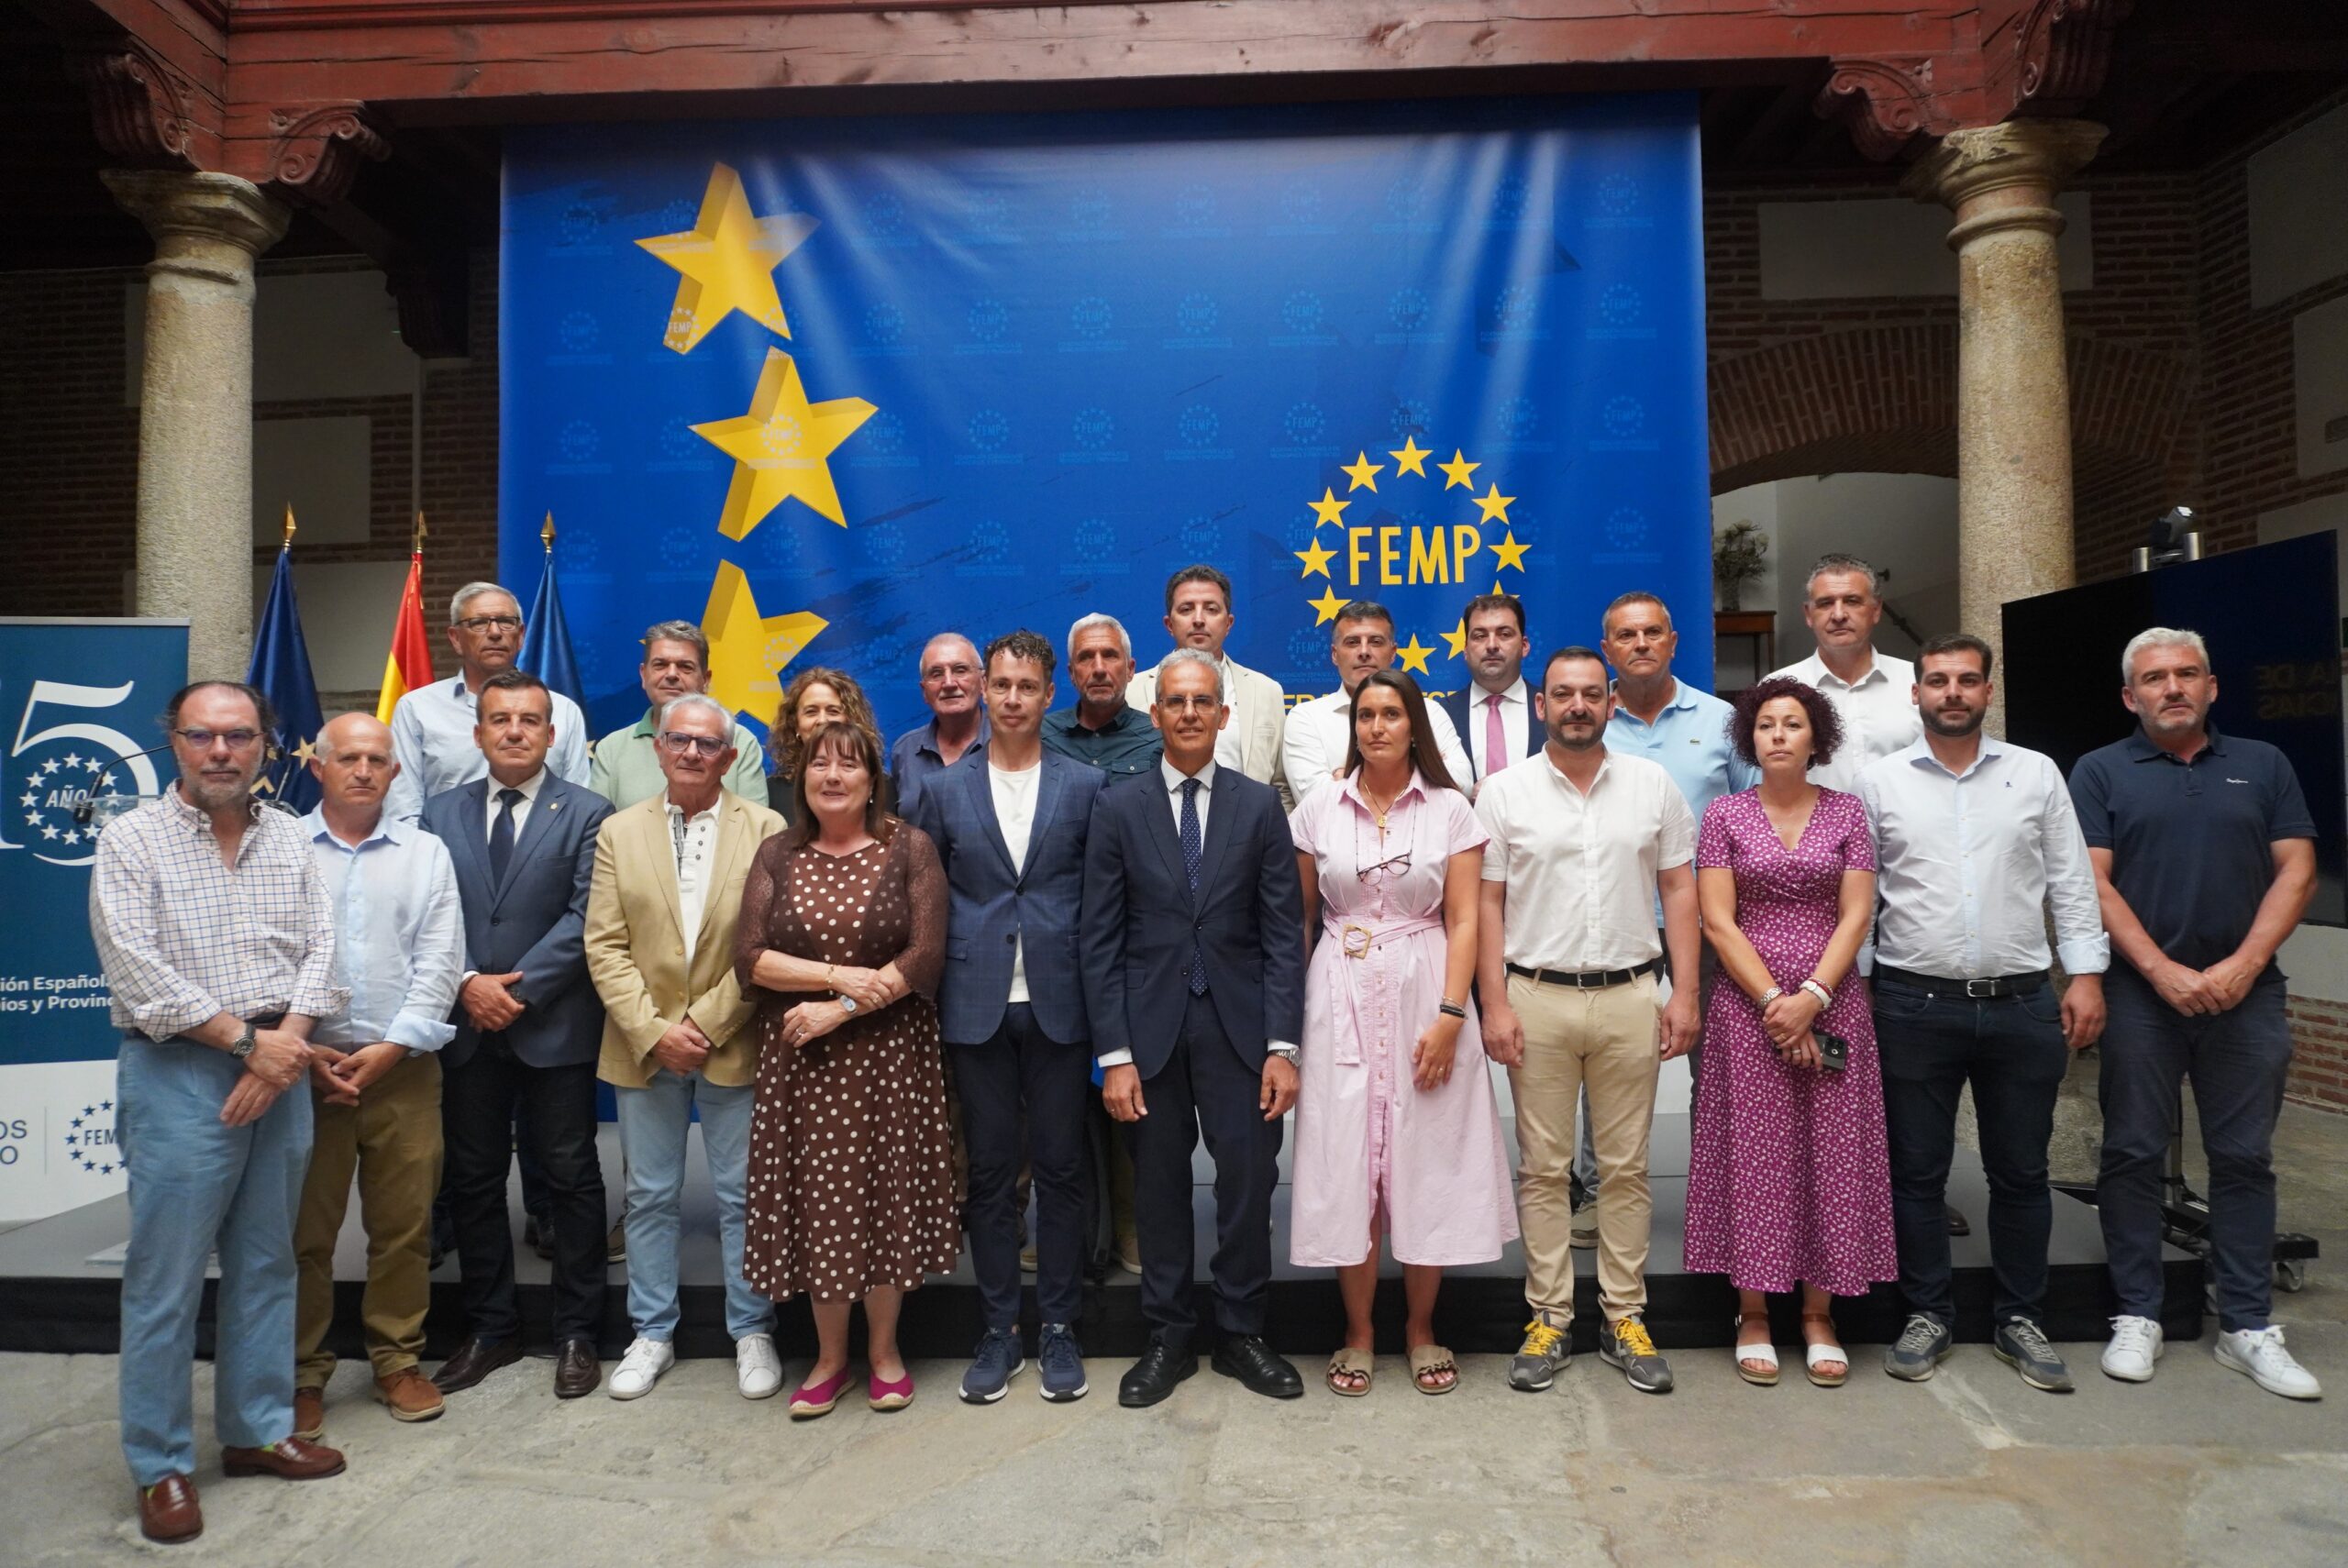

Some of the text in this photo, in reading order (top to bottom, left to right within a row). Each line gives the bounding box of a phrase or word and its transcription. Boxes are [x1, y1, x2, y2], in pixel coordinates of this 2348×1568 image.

[669, 321, 691, 334] FEMP
[1186, 419, 1212, 432] FEMP
[1292, 417, 1317, 429] FEMP
[1398, 414, 1423, 425] FEMP
[872, 427, 897, 439] FEMP
[977, 425, 1001, 436] FEMP
[1081, 422, 1106, 434] FEMP
[872, 537, 897, 549] FEMP
[1188, 531, 1213, 543] FEMP
[1349, 525, 1481, 585] FEMP
[1296, 641, 1321, 654] FEMP
[45, 784, 94, 808] AÑO
[33, 974, 109, 994] Español
[30, 999, 44, 1014] y
